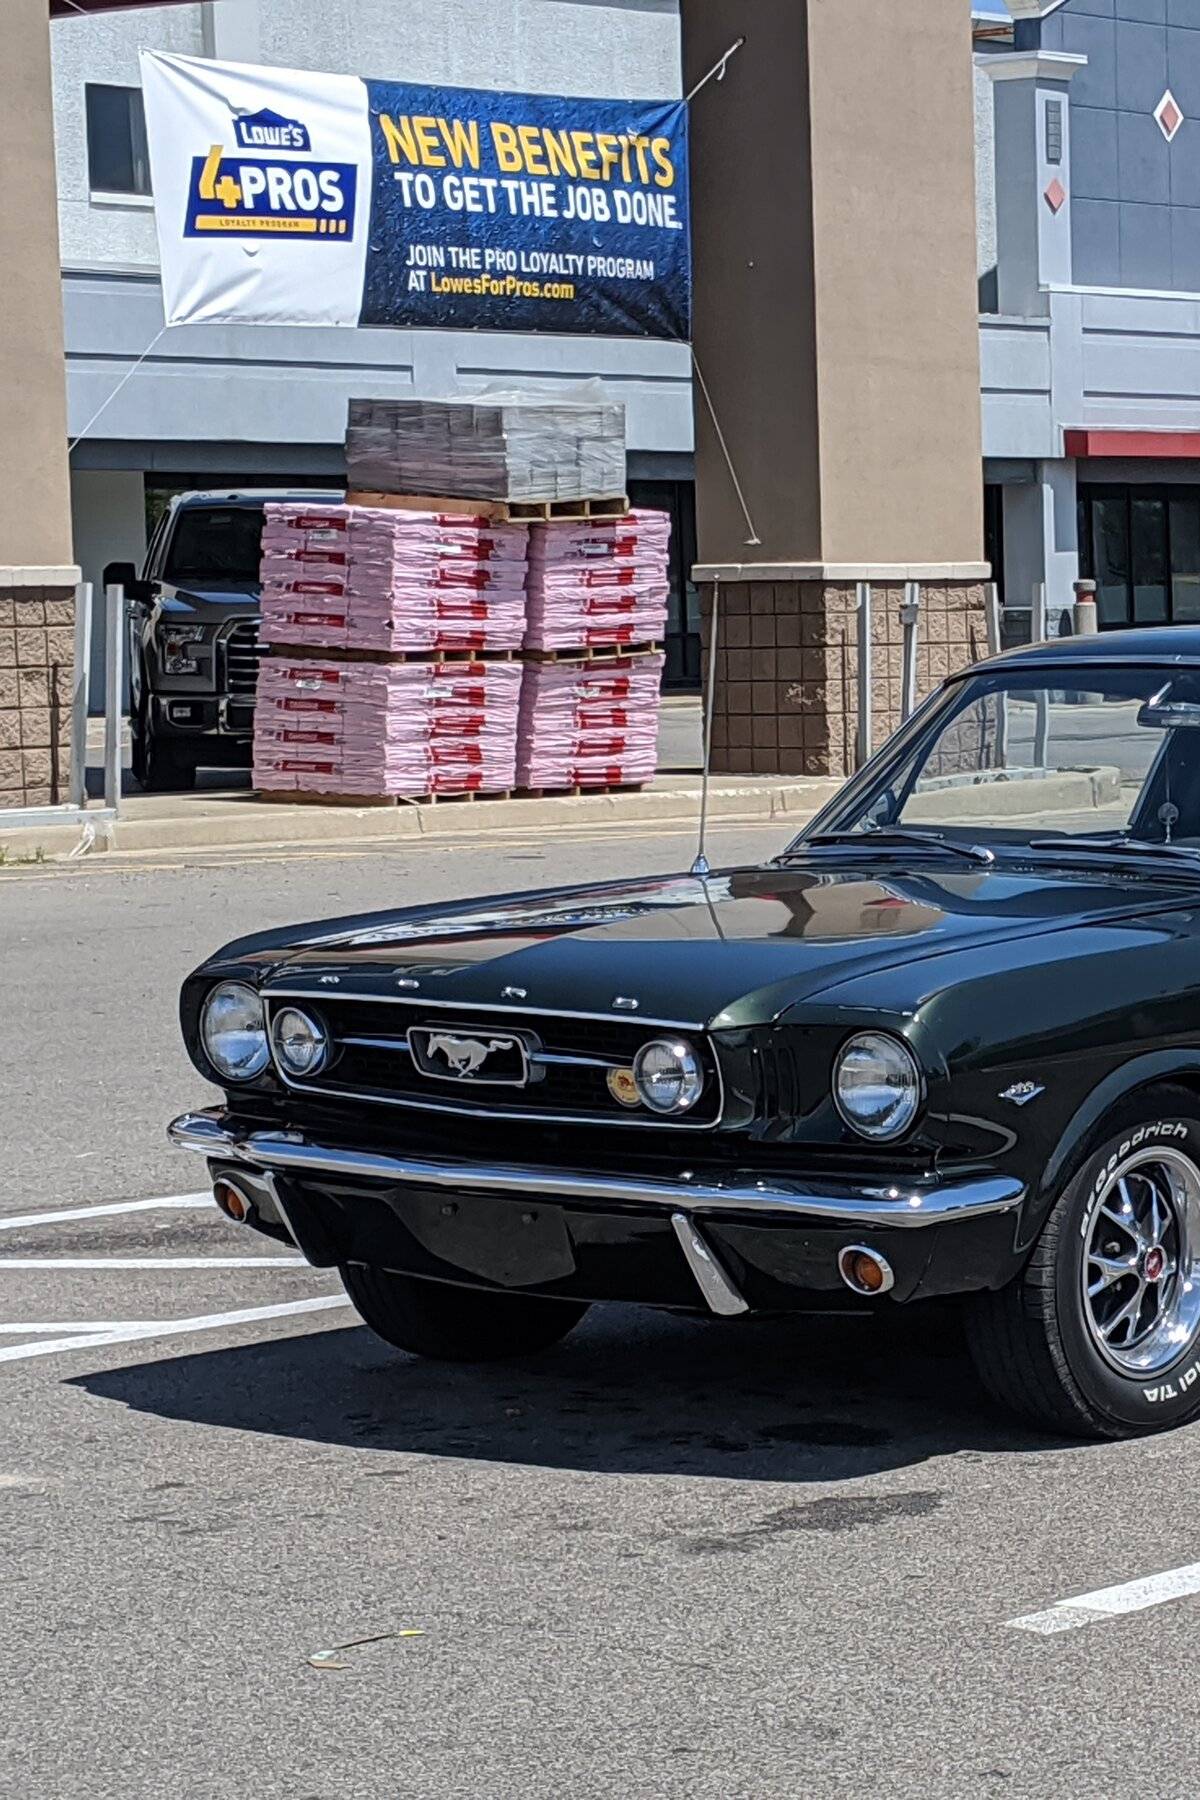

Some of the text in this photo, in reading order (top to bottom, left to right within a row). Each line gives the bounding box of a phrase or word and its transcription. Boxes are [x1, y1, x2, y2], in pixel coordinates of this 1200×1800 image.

[240, 122, 304, 147] LOWE'S
[379, 114, 674, 188] NEW BENEFITS
[394, 172, 683, 230] TO GET THE JOB DONE.
[219, 219, 300, 228] LOYALTY PROGRAM
[405, 244, 655, 280] JOIN THE PRO LOYALTY PROGRAM
[407, 269, 575, 299] AT LowesForPros.com
[1143, 1384, 1178, 1402] T/A
